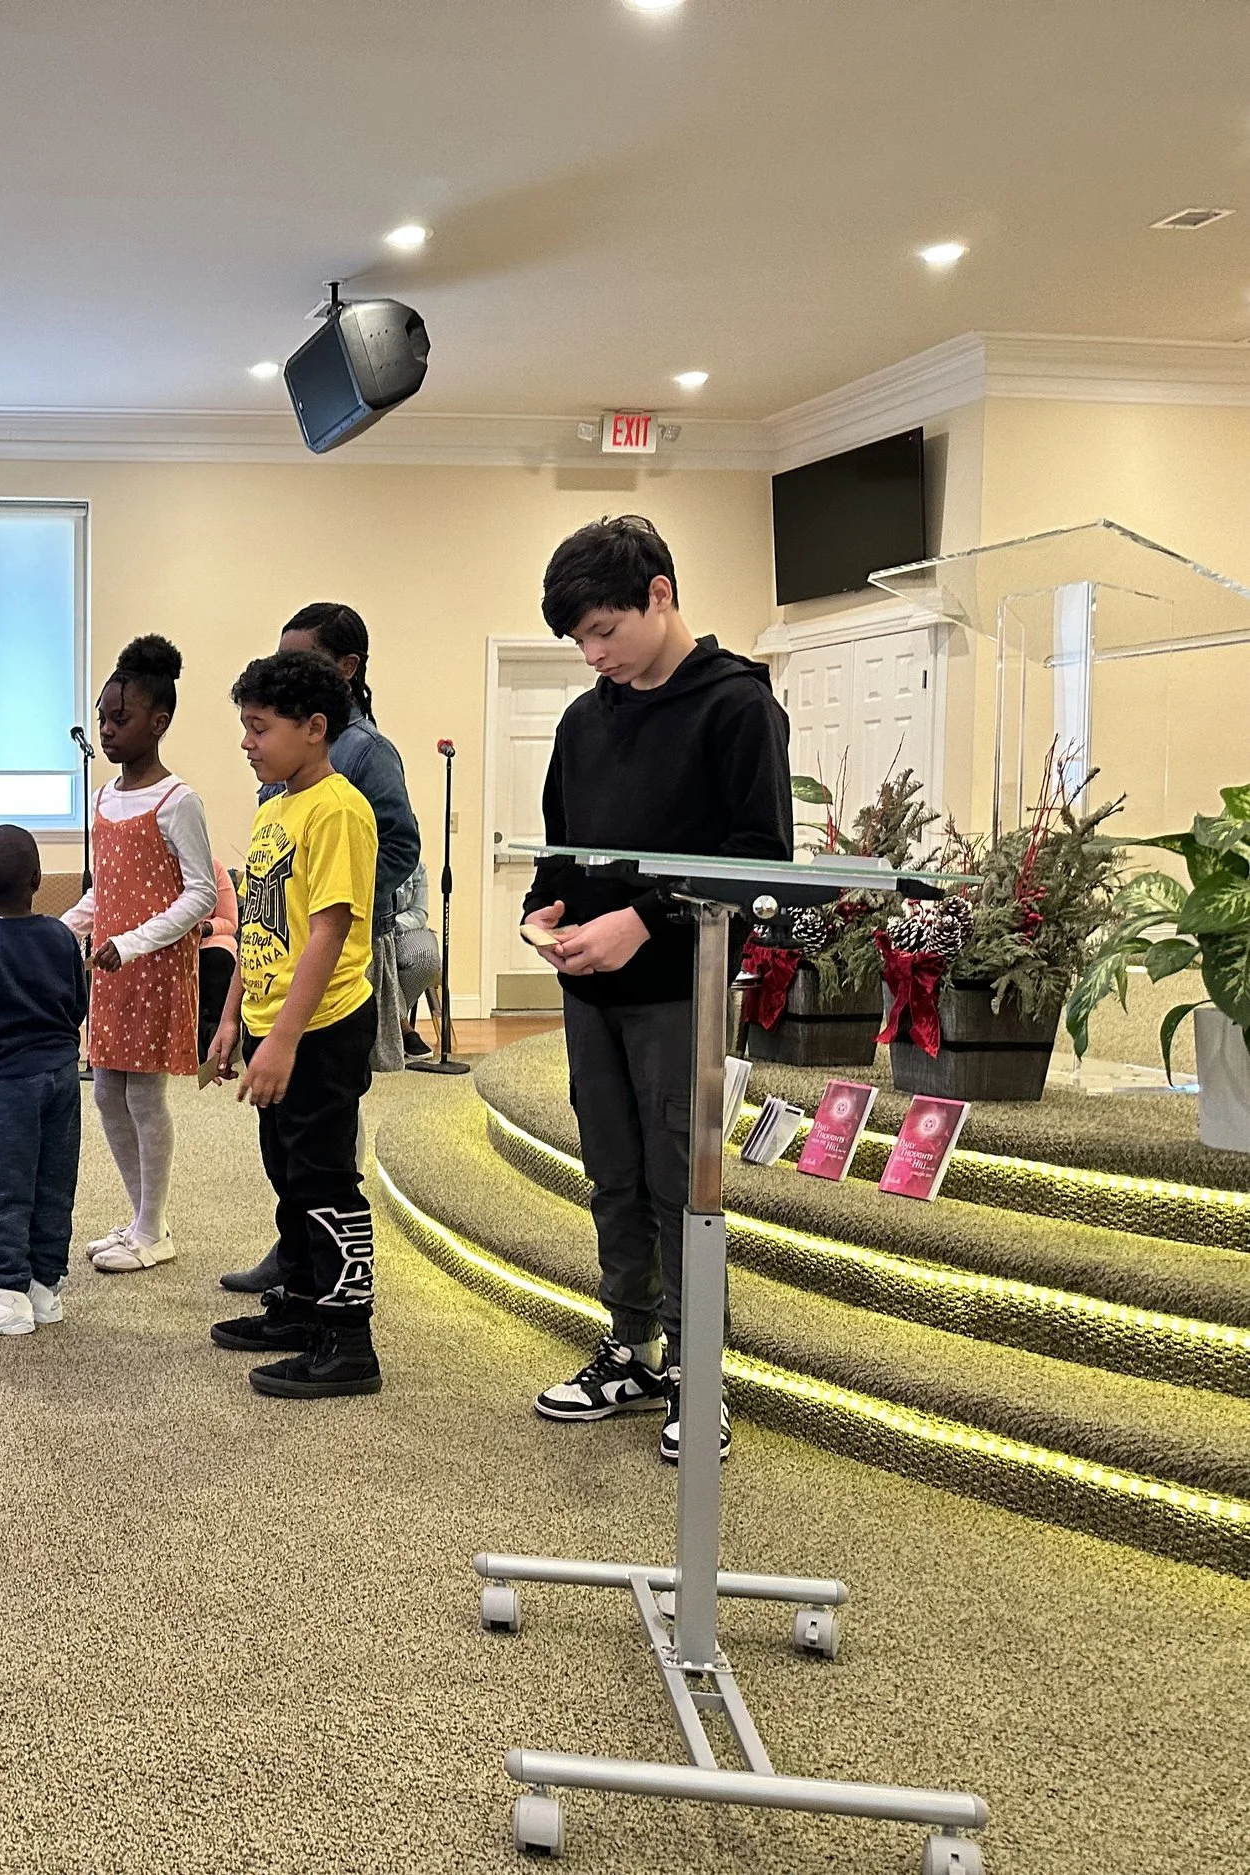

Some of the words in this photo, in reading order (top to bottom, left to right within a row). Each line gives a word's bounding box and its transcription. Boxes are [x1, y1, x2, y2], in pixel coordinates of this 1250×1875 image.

[612, 416, 651, 447] EXIT
[263, 972, 278, 995] 7
[901, 1148, 933, 1161] THOUGHTS
[911, 1159, 927, 1170] HILL
